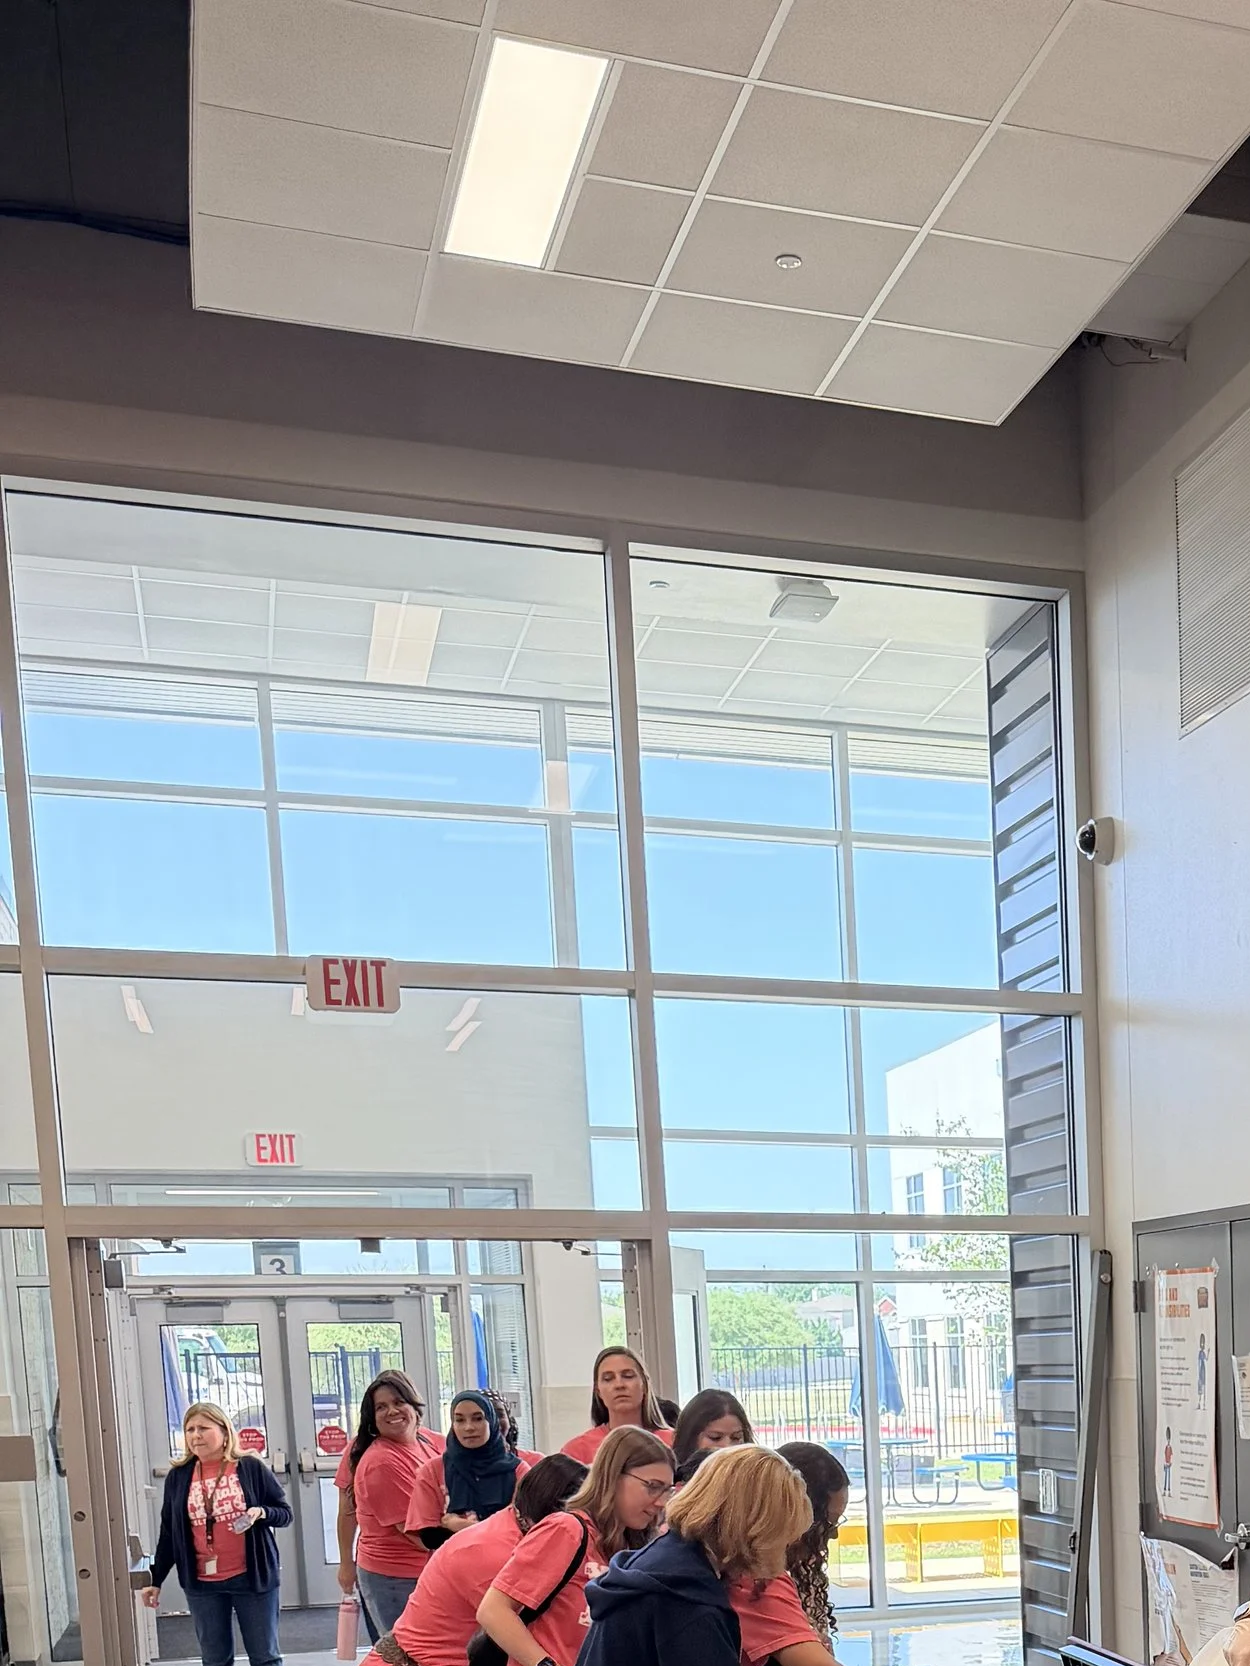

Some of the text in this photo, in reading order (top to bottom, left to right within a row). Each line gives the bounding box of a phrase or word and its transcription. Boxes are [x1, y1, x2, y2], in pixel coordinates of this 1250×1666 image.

[322, 958, 387, 1008] EXIT
[255, 1133, 296, 1164] EXIT
[269, 1258, 287, 1275] 3
